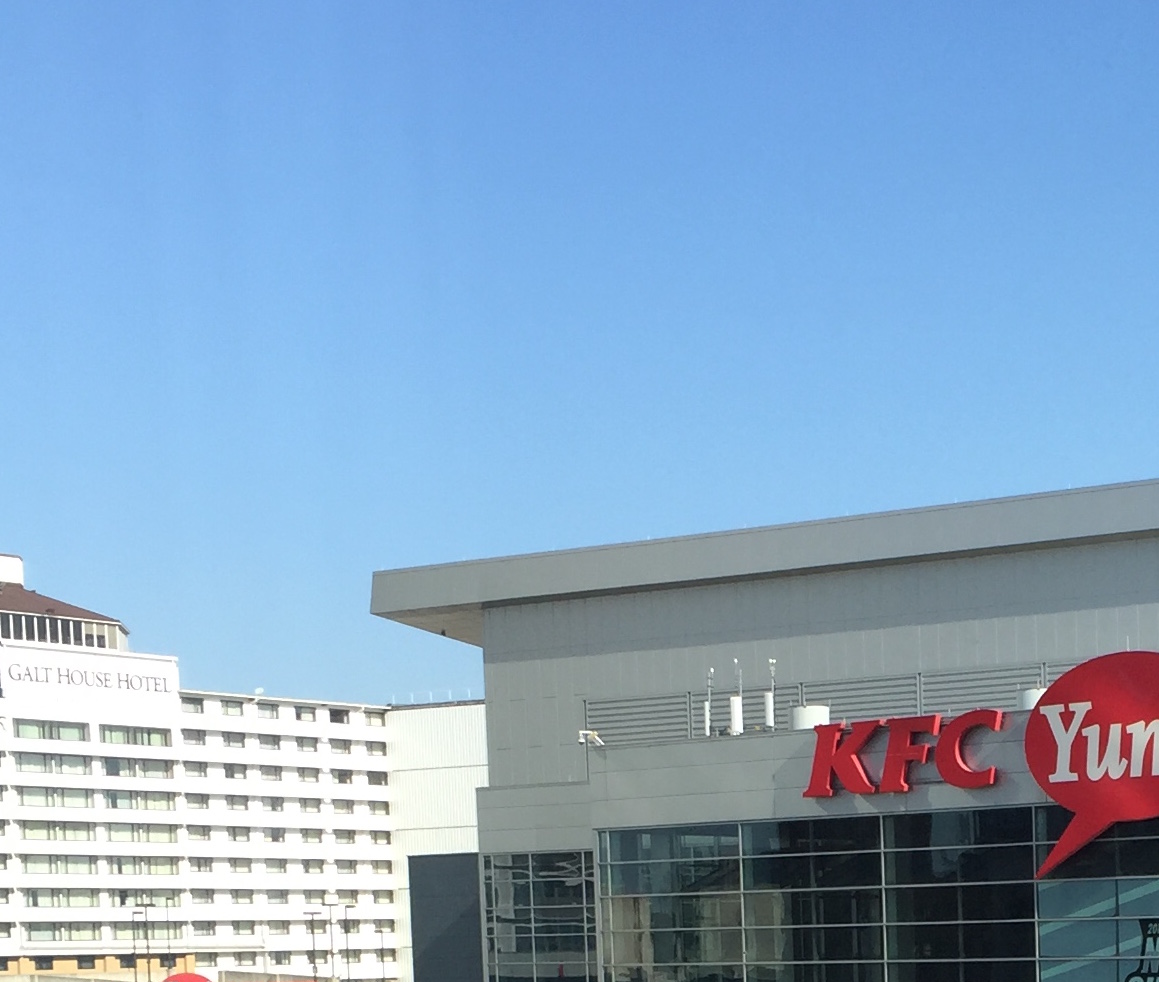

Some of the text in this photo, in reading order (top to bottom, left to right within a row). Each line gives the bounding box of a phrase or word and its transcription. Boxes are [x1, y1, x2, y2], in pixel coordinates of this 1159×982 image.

[8, 663, 172, 693] GALT HOUSE HOTEL
[803, 708, 1004, 798] KFC
